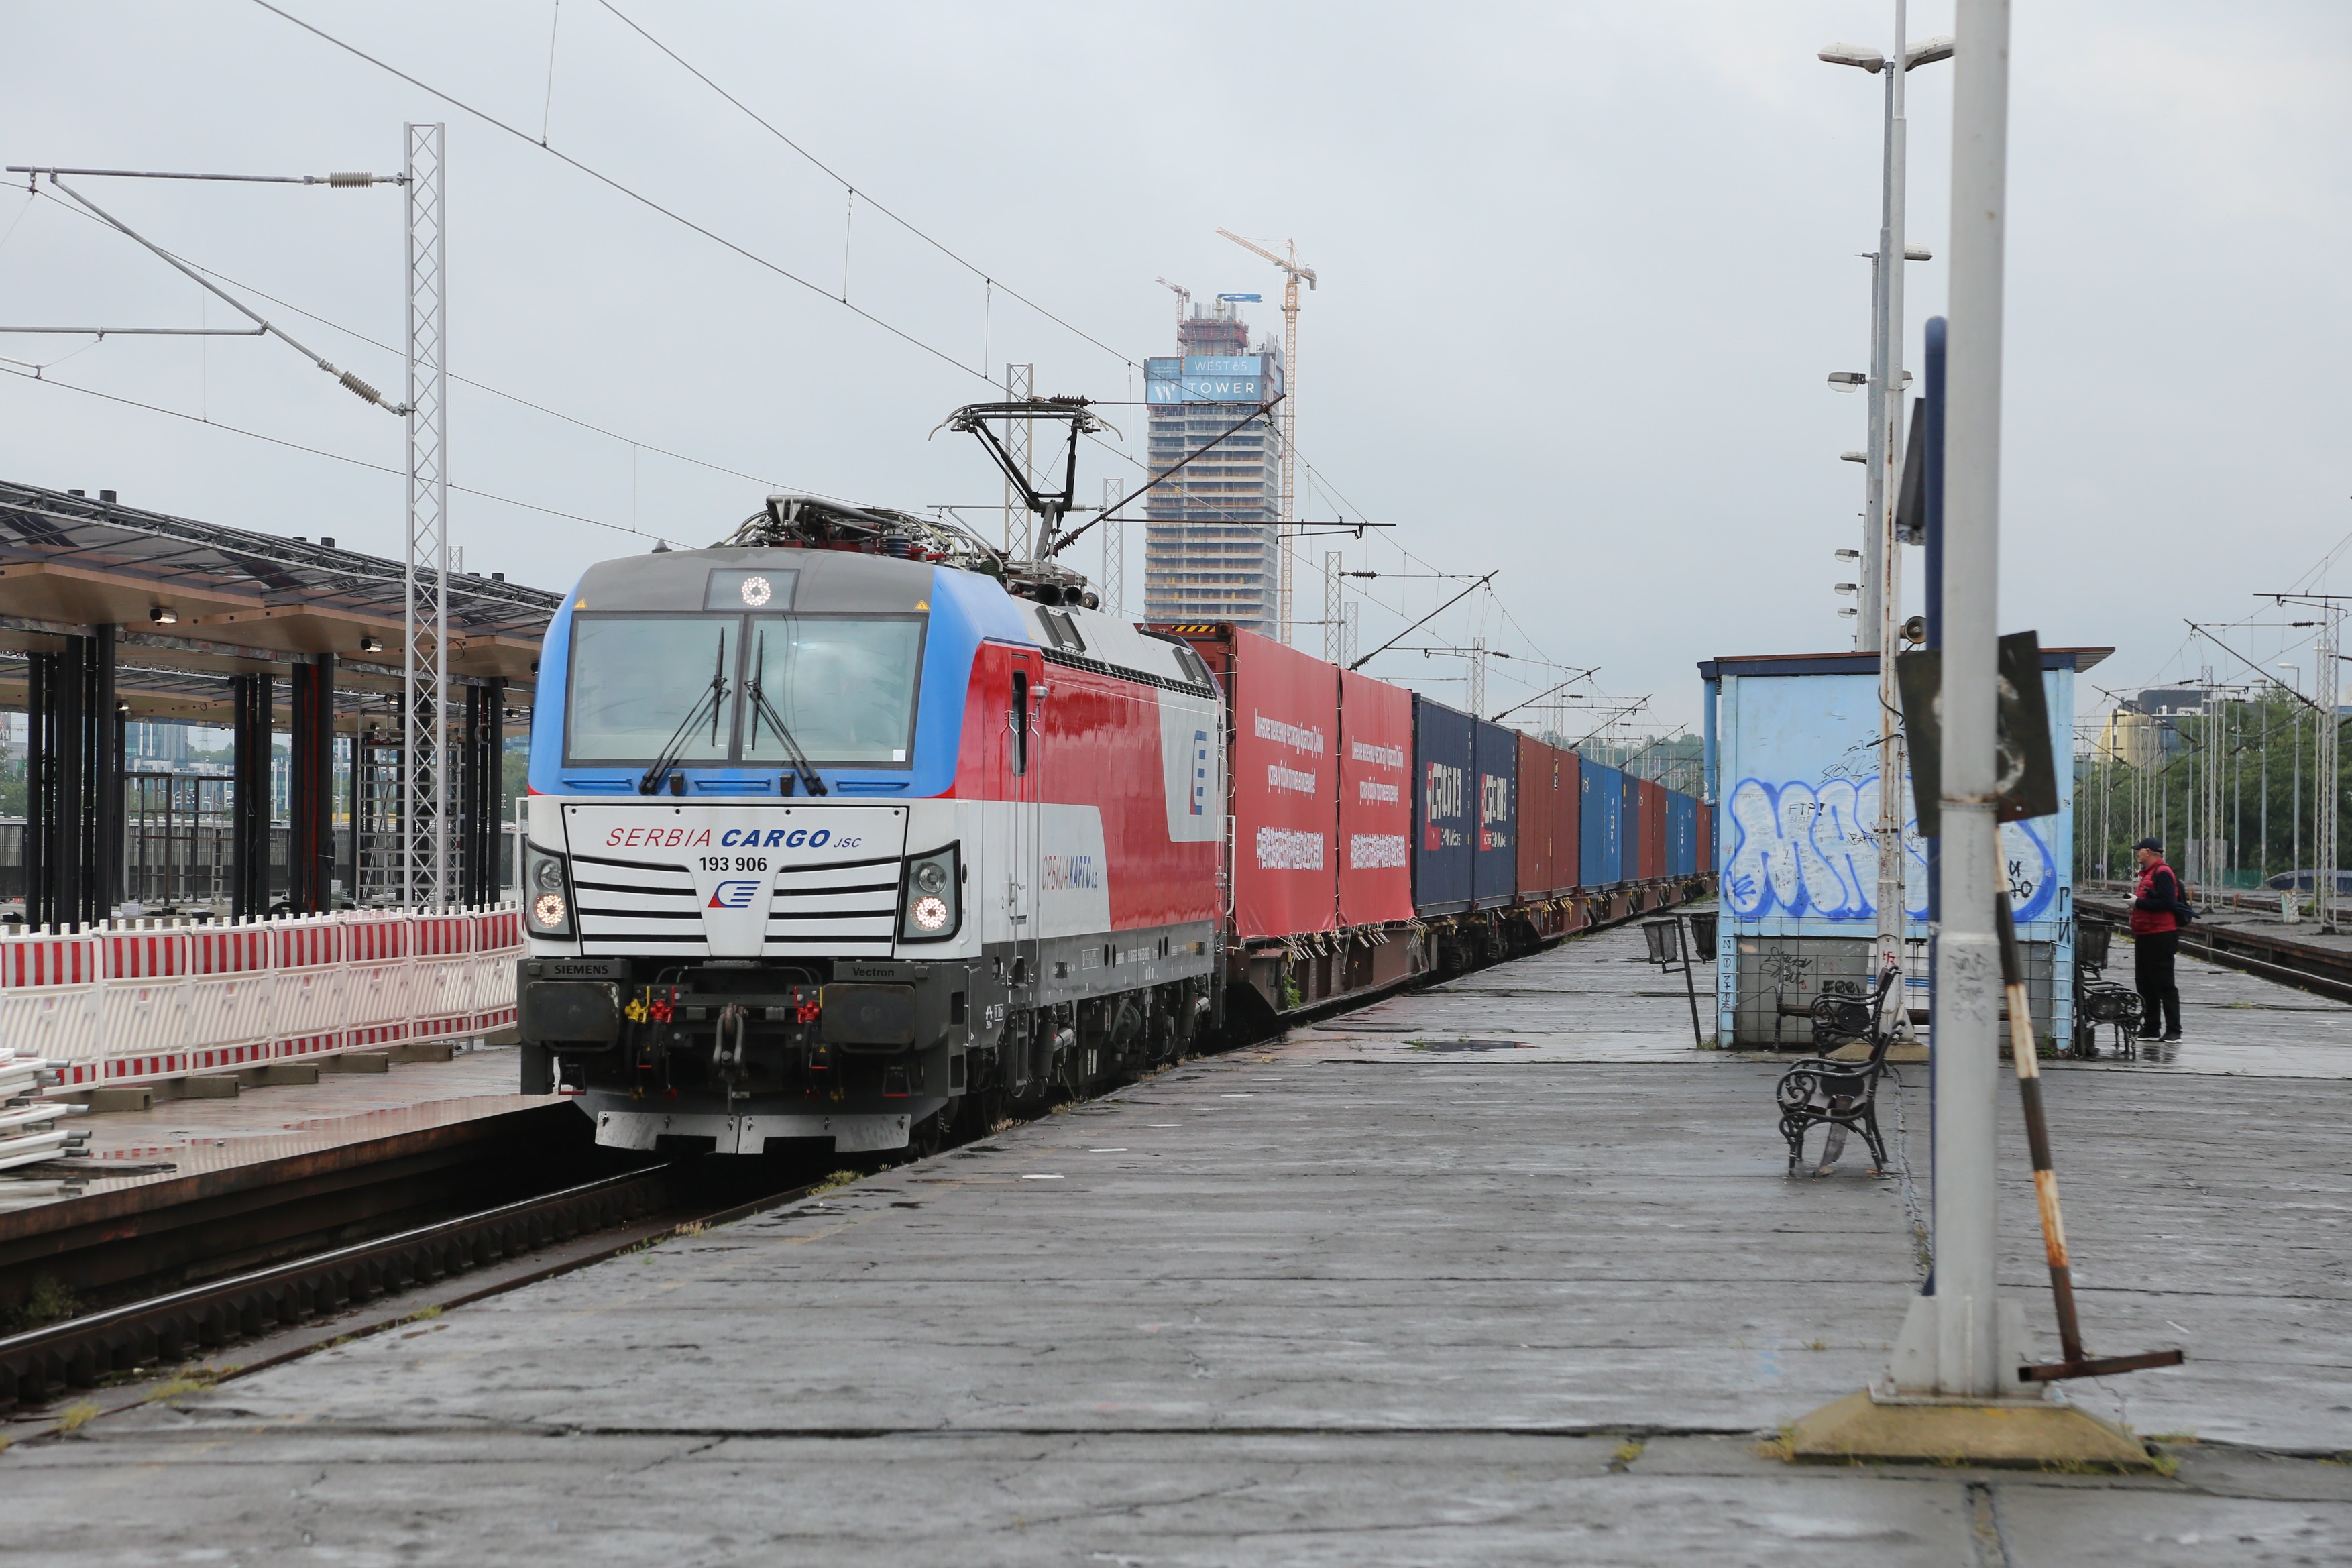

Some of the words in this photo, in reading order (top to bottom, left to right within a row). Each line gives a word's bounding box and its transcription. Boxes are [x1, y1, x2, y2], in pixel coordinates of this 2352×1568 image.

[1195, 361, 1230, 371] WEST
[1233, 361, 1247, 371] 65
[1188, 382, 1255, 394] TOWER
[606, 828, 712, 848] SERBIA
[721, 828, 831, 848] CARGO
[833, 837, 862, 848] JSC
[699, 856, 730, 872] 193
[734, 856, 768, 872] 906
[1042, 855, 1068, 891] СРБИЈА
[1069, 856, 1091, 889] КАРГО
[554, 964, 609, 974] SIEMENS
[852, 966, 895, 977] Vectron
